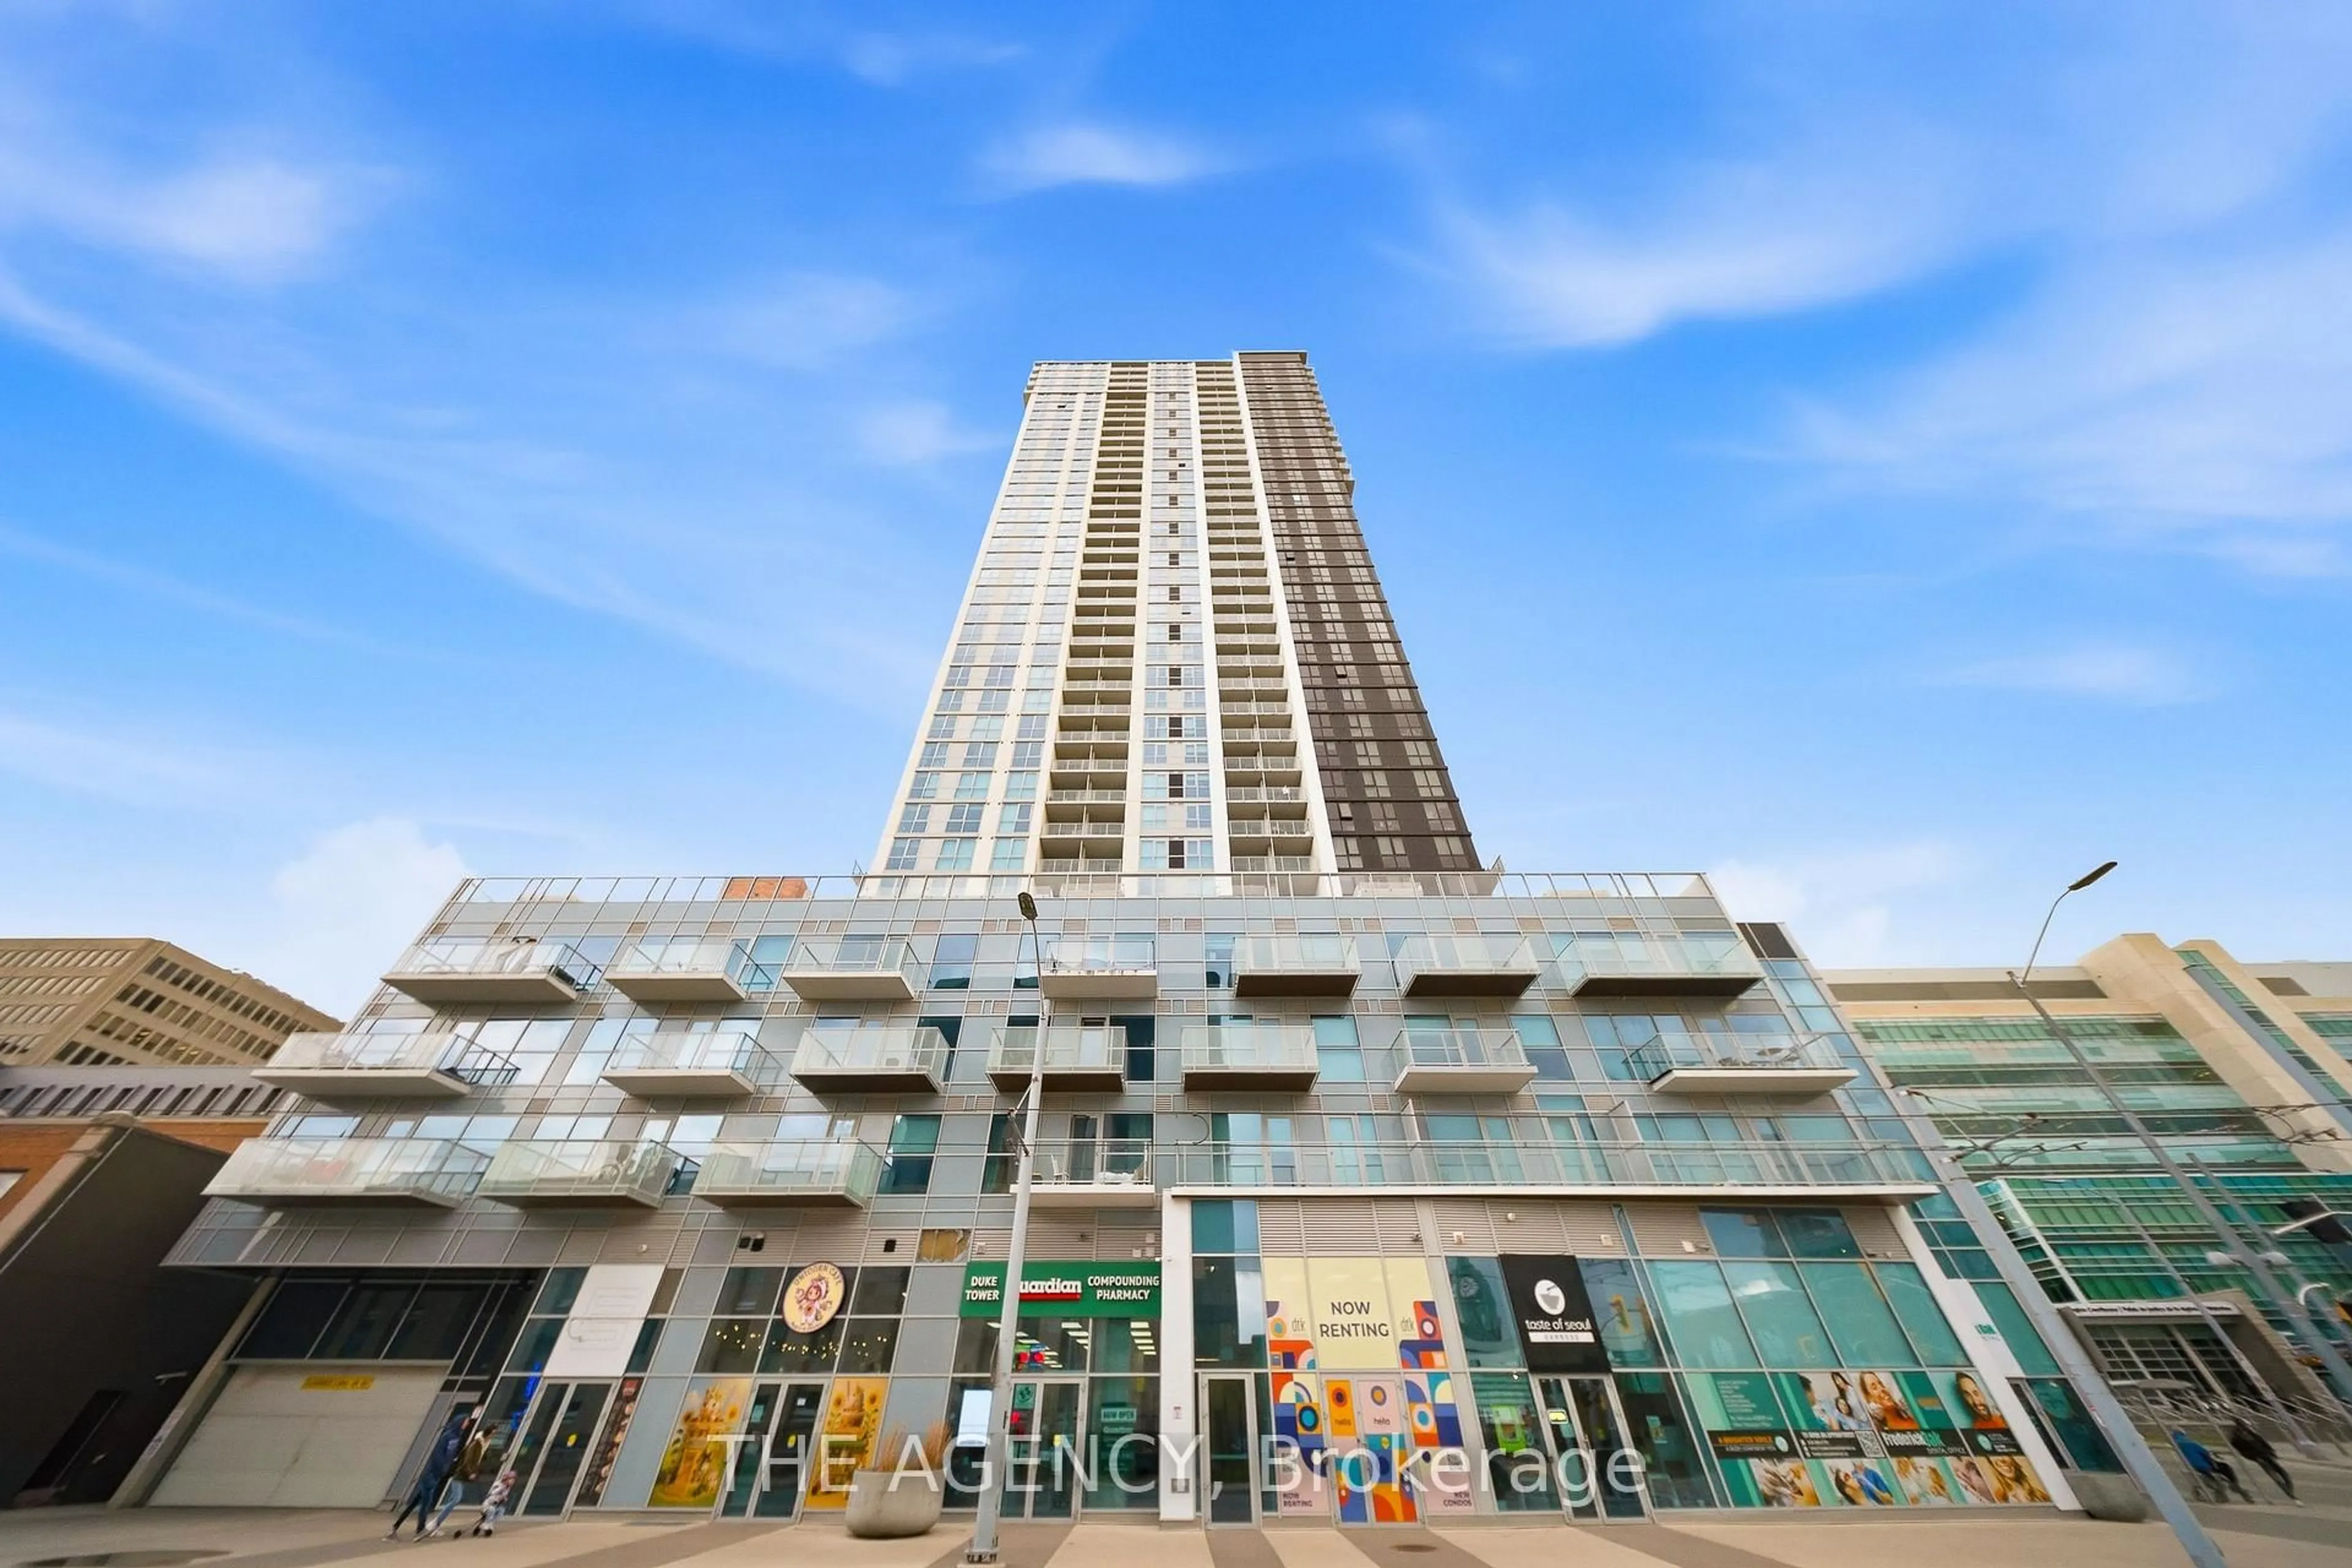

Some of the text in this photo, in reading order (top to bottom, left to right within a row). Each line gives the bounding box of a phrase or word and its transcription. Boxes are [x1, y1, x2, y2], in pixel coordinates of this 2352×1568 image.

[971, 1276, 998, 1287] DUKE
[1020, 1278, 1082, 1294] uardian
[1088, 1276, 1159, 1287] COMPOUNDING
[965, 1290, 999, 1301] TOWER
[1096, 1289, 1150, 1300] PHARMACY
[1331, 1302, 1371, 1315] NOW
[1525, 1318, 1593, 1330] taste of seoul
[1319, 1323, 1389, 1338] RENTING
